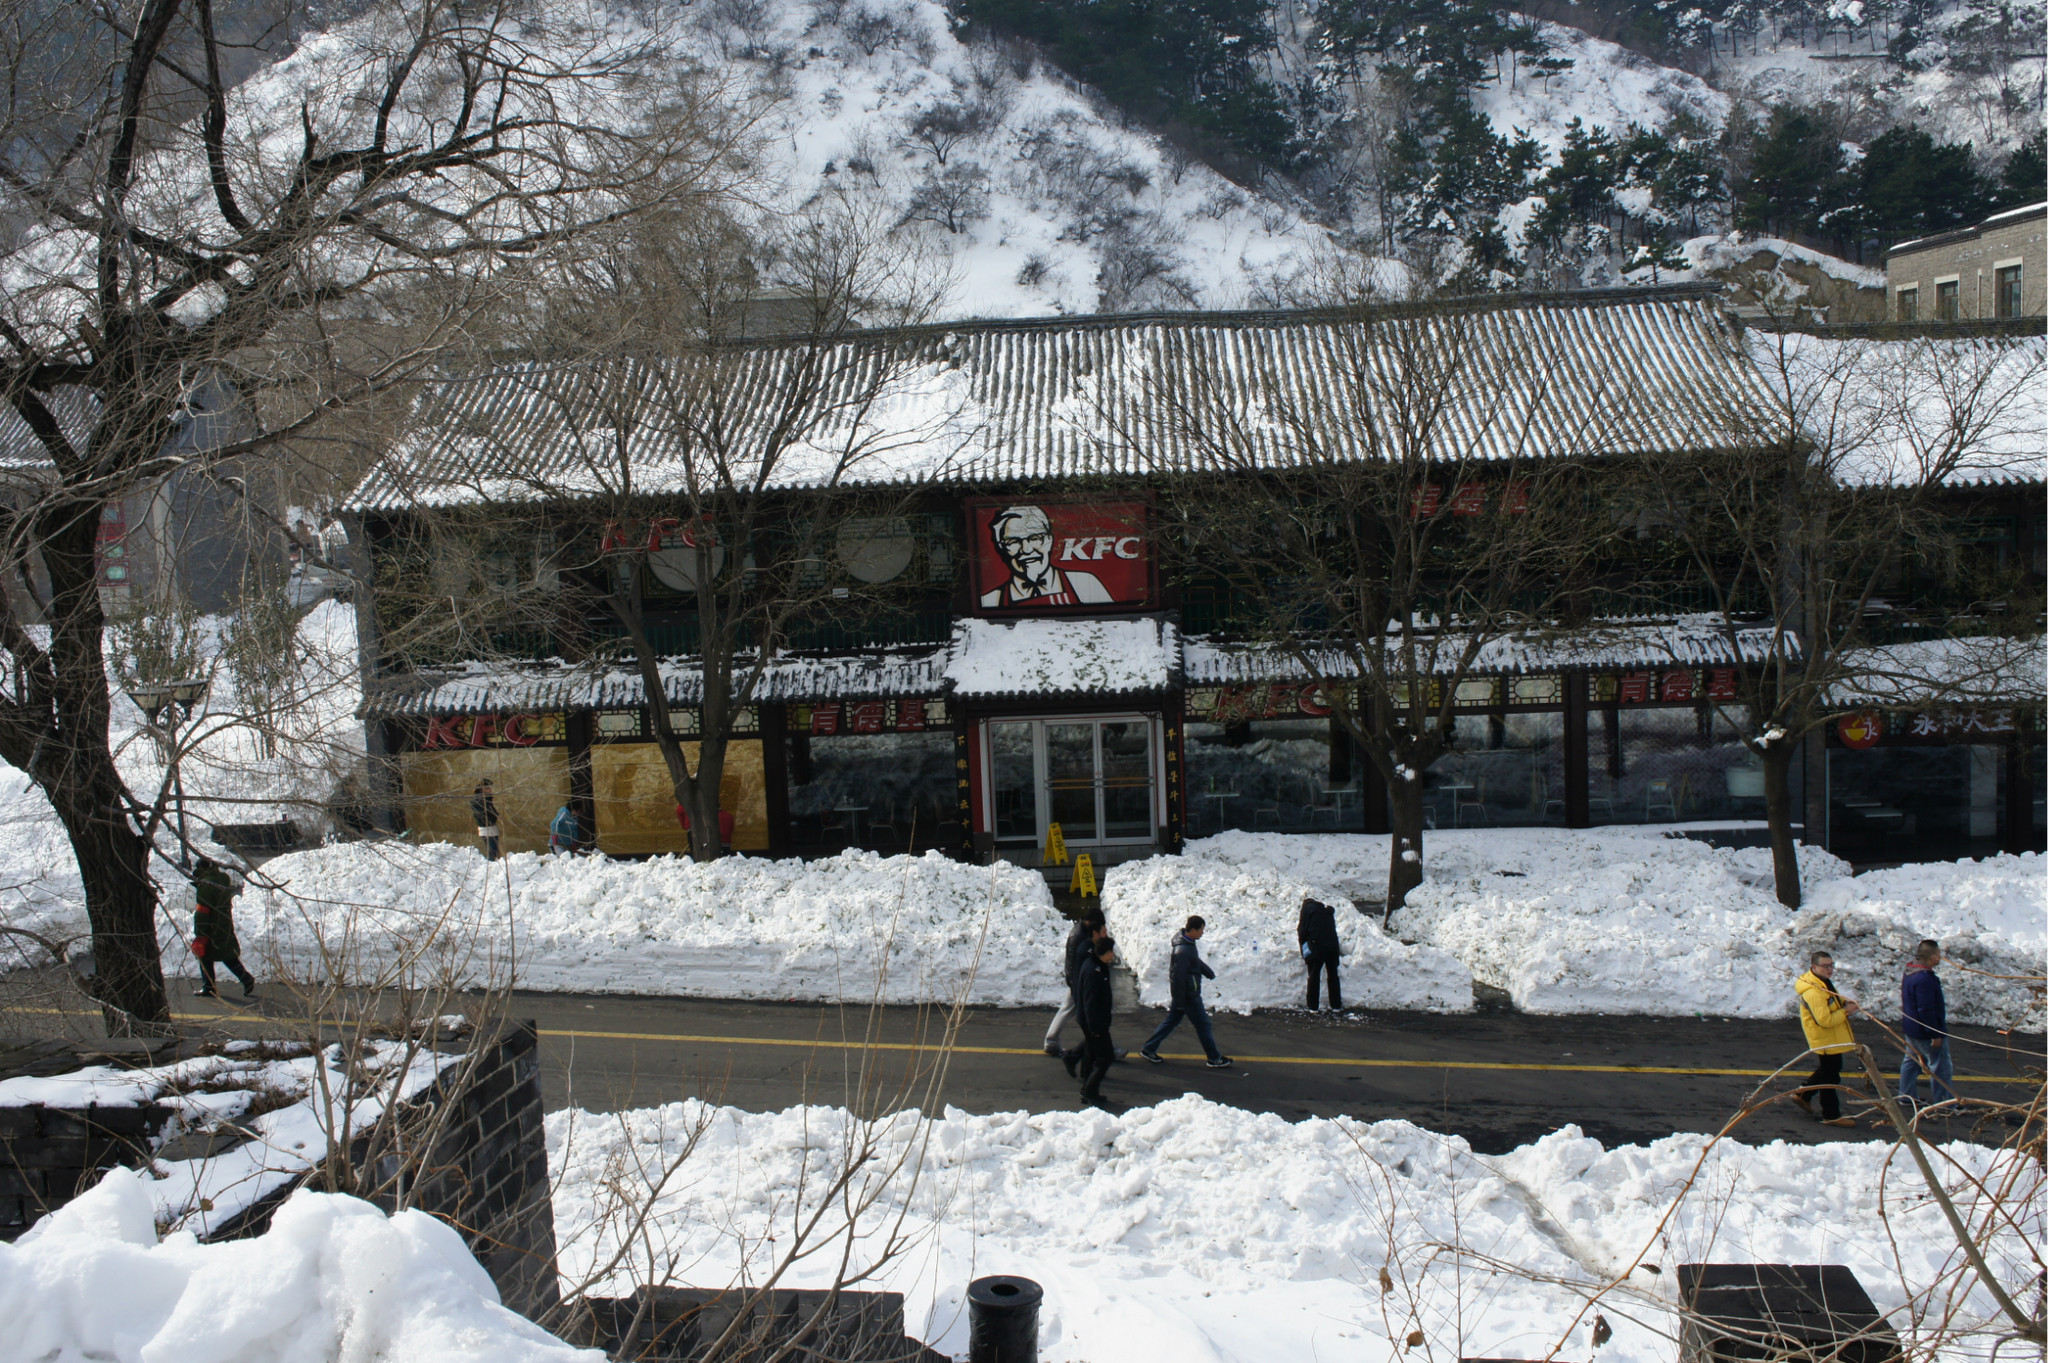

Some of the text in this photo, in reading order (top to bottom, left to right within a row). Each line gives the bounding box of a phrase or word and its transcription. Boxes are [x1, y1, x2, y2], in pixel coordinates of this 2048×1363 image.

[1059, 536, 1140, 561] KFC
[1620, 668, 1739, 704] 肯德基
[420, 713, 540, 749] KFC
[812, 699, 927, 735] 肯德基
